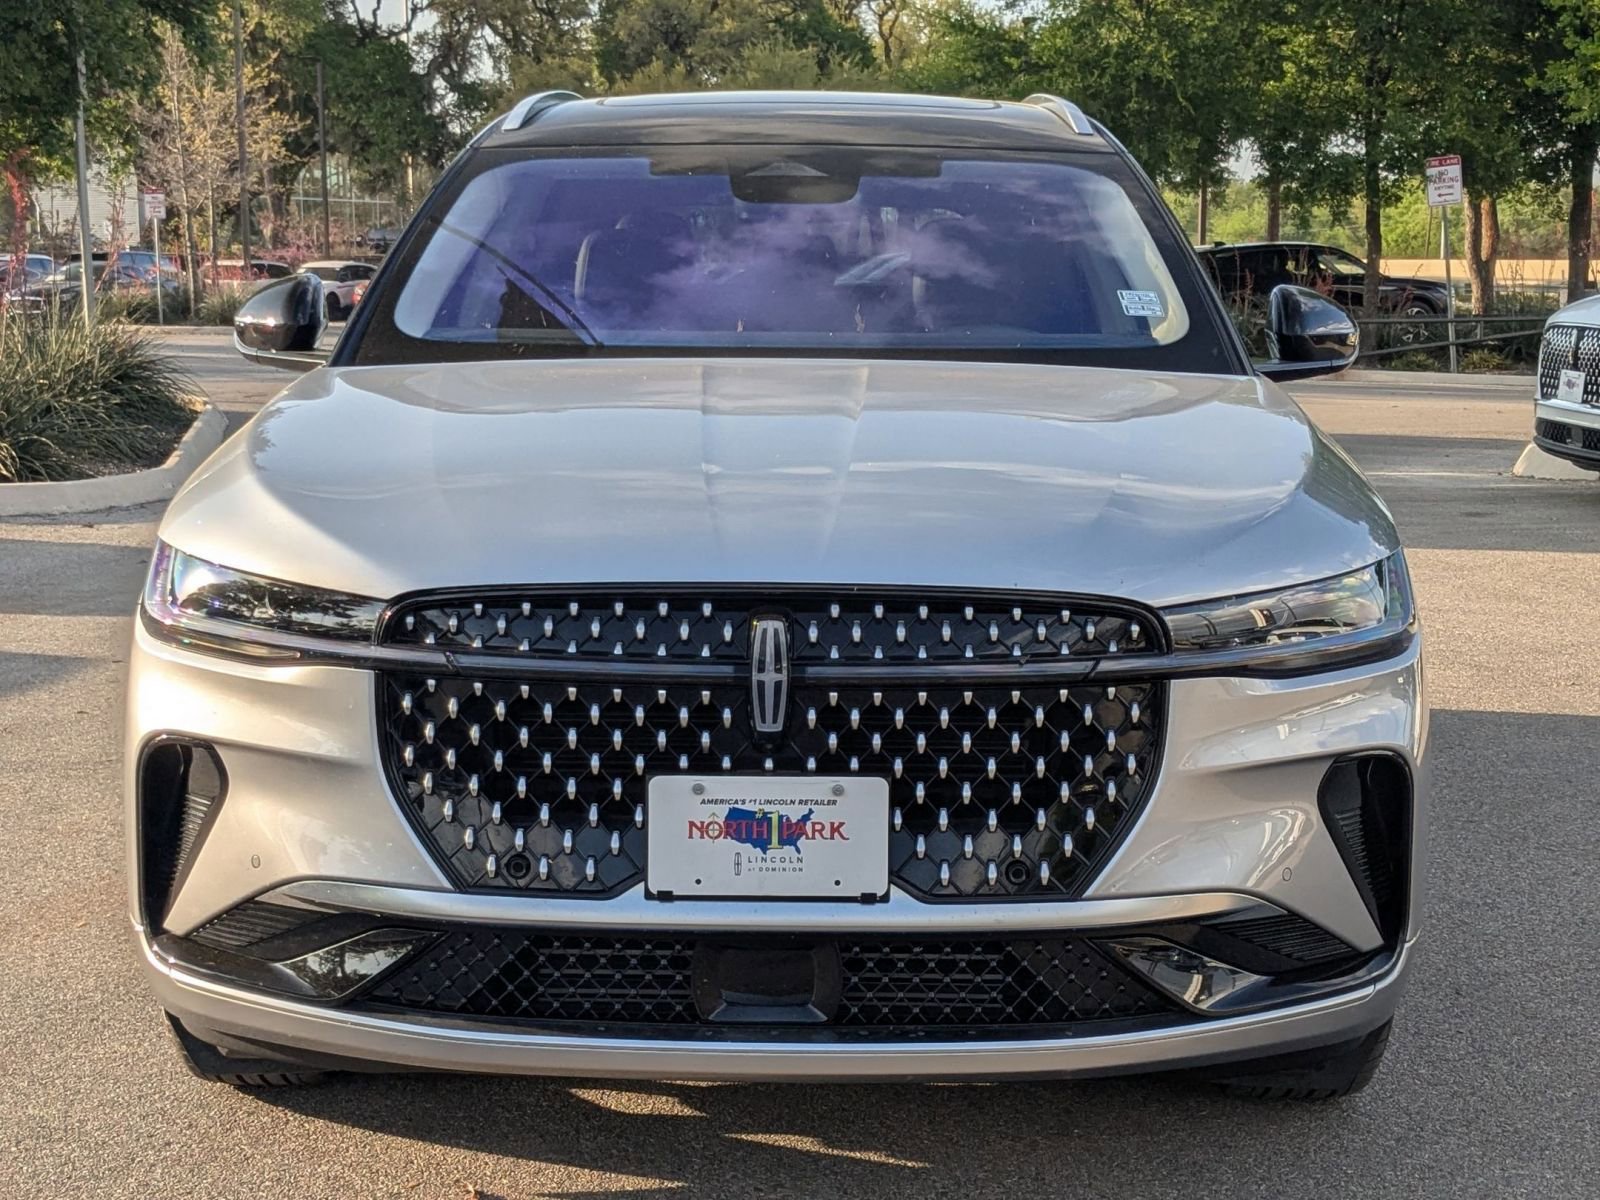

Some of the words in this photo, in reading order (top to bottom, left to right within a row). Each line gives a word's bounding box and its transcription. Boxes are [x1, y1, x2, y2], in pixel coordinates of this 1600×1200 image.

[700, 798, 747, 806] AMERICA'S
[688, 820, 768, 840] NORTH
[783, 820, 850, 841] PARK
[747, 856, 804, 864] LINCOLN
